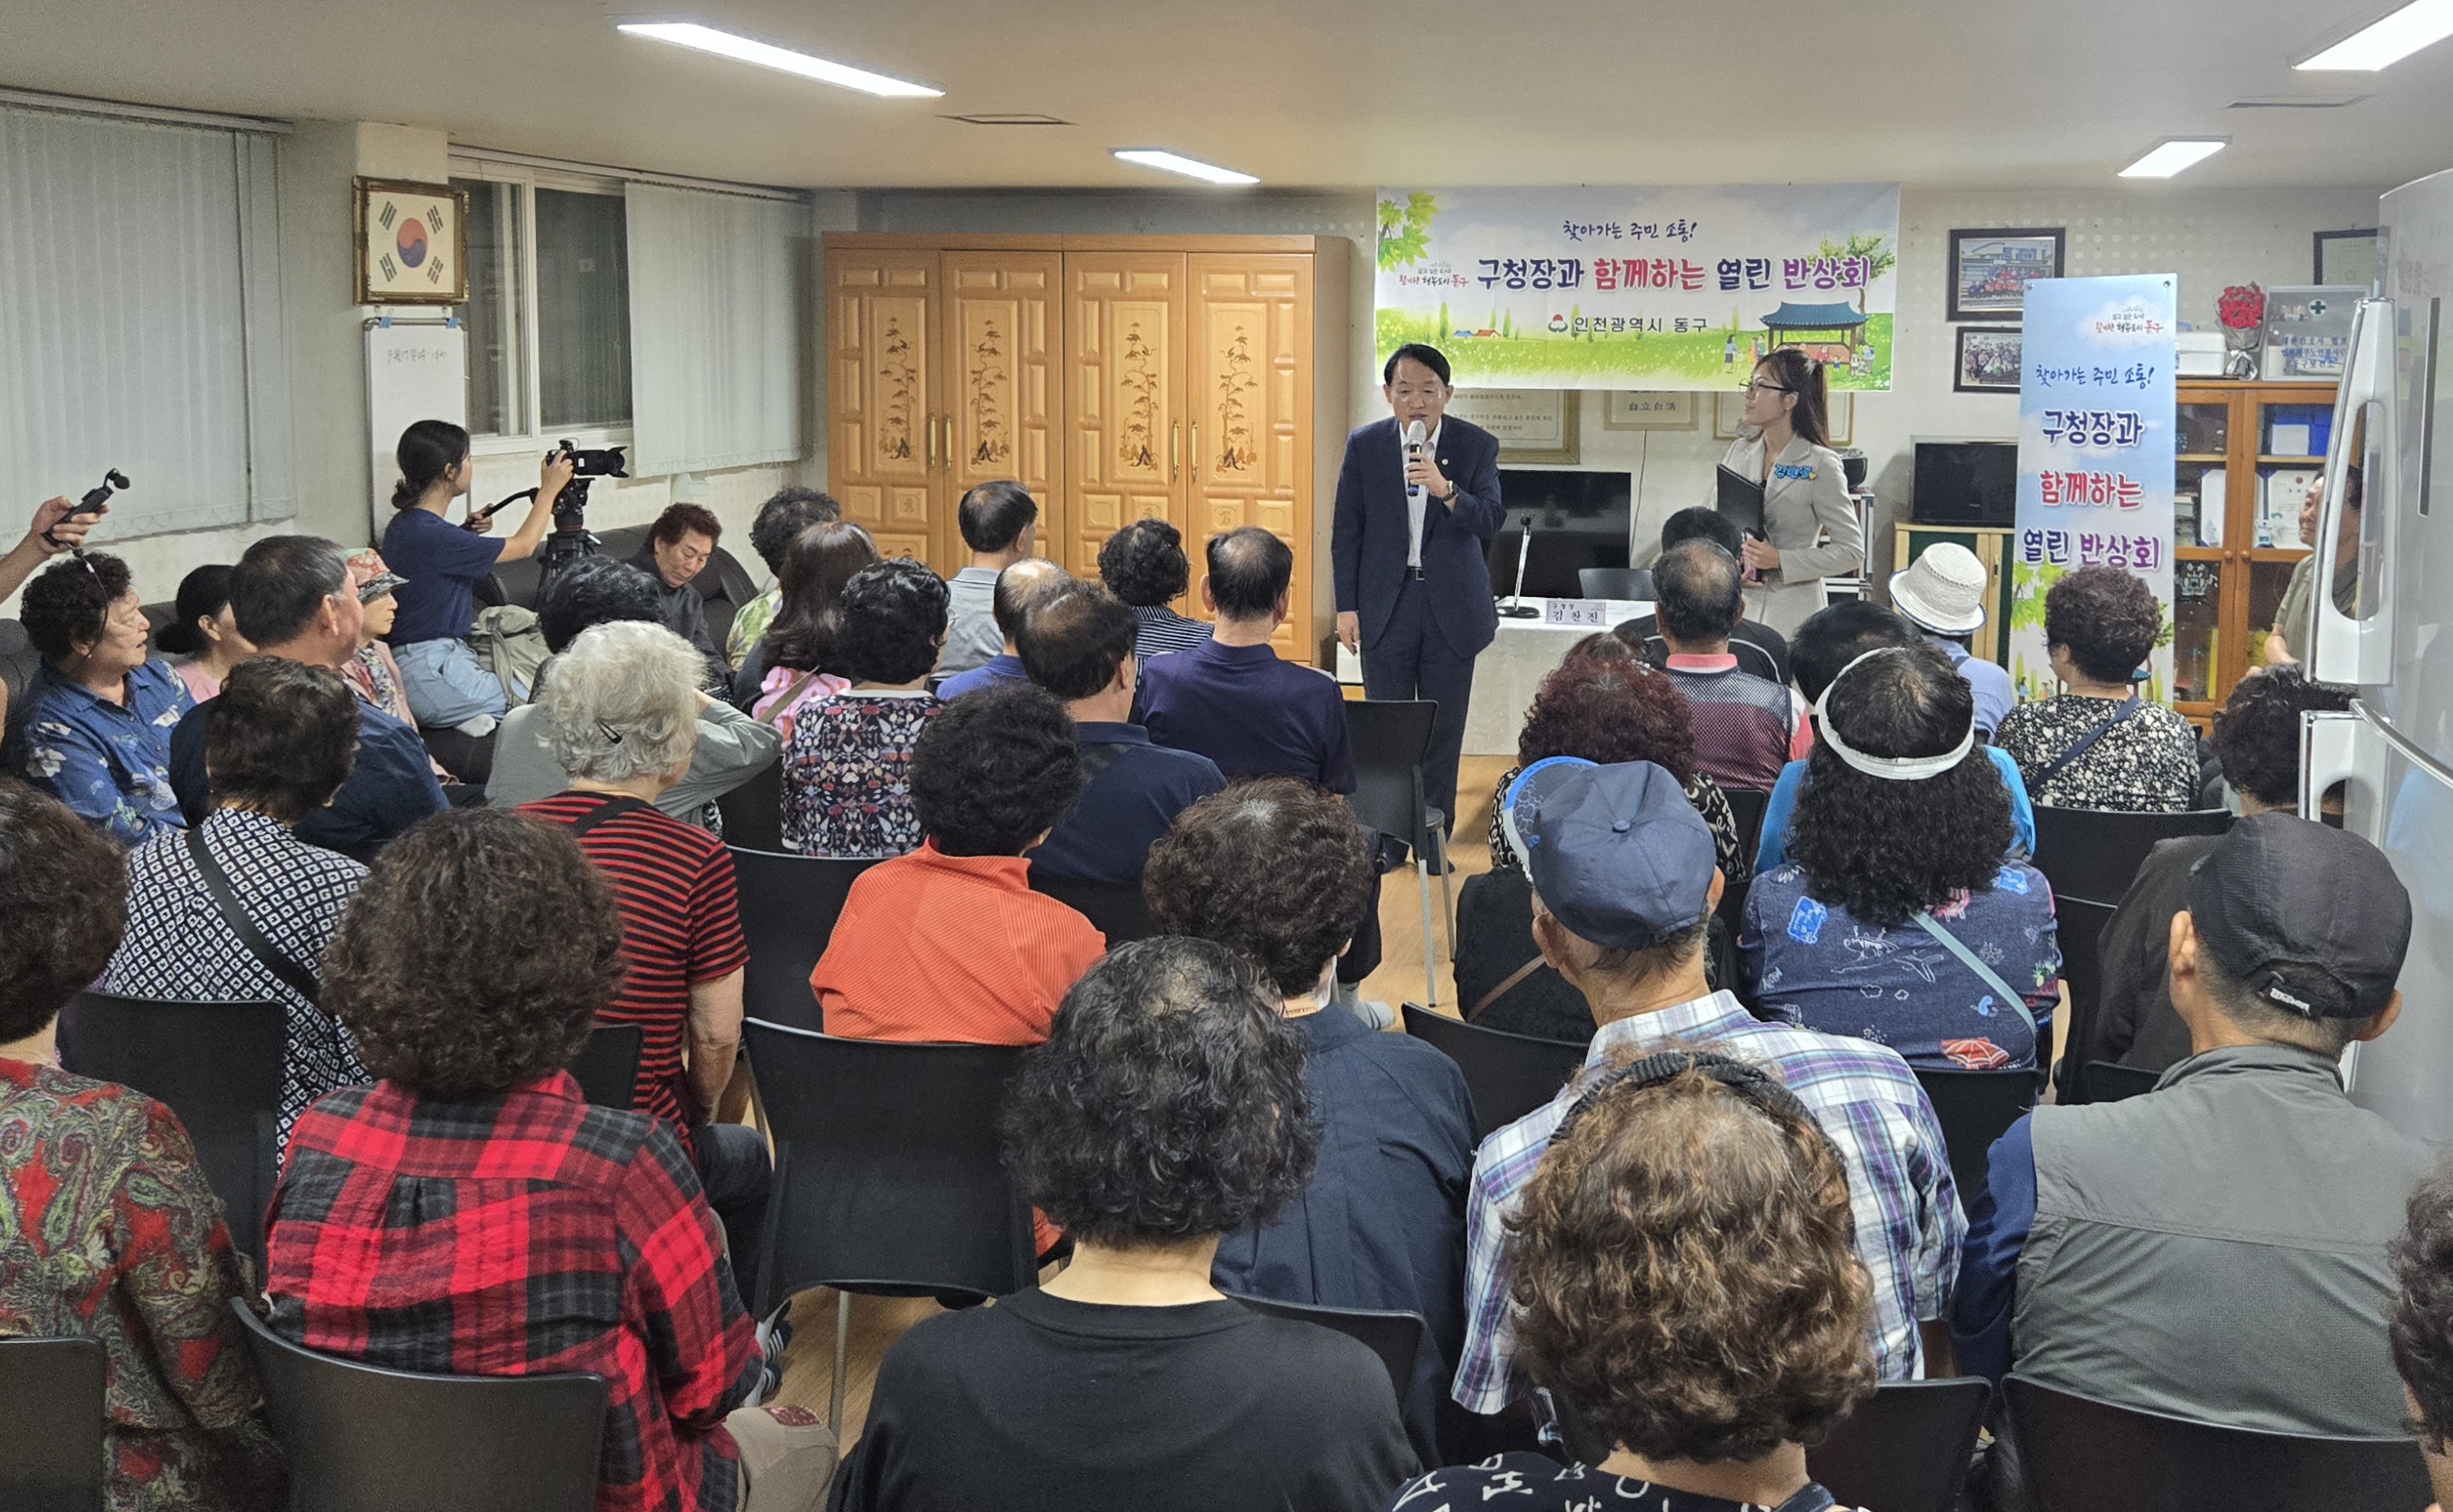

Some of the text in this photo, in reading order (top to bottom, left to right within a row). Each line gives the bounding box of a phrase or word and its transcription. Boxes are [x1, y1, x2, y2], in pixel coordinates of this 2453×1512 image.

[1562, 219, 1698, 243] 찾아가는 주민 소통!
[1451, 274, 1471, 287] 동구
[1477, 257, 1870, 291] 구청장과 함께하는 열린 반상회
[1574, 316, 1708, 333] 인천광역시 동구
[2143, 319, 2165, 334] 동구
[2035, 363, 2155, 389] 찾아가는 주민 소통!
[2042, 410, 2143, 446] 구청장과
[2040, 469, 2142, 509] 함께하는
[2023, 528, 2160, 569] 열린 반상회
